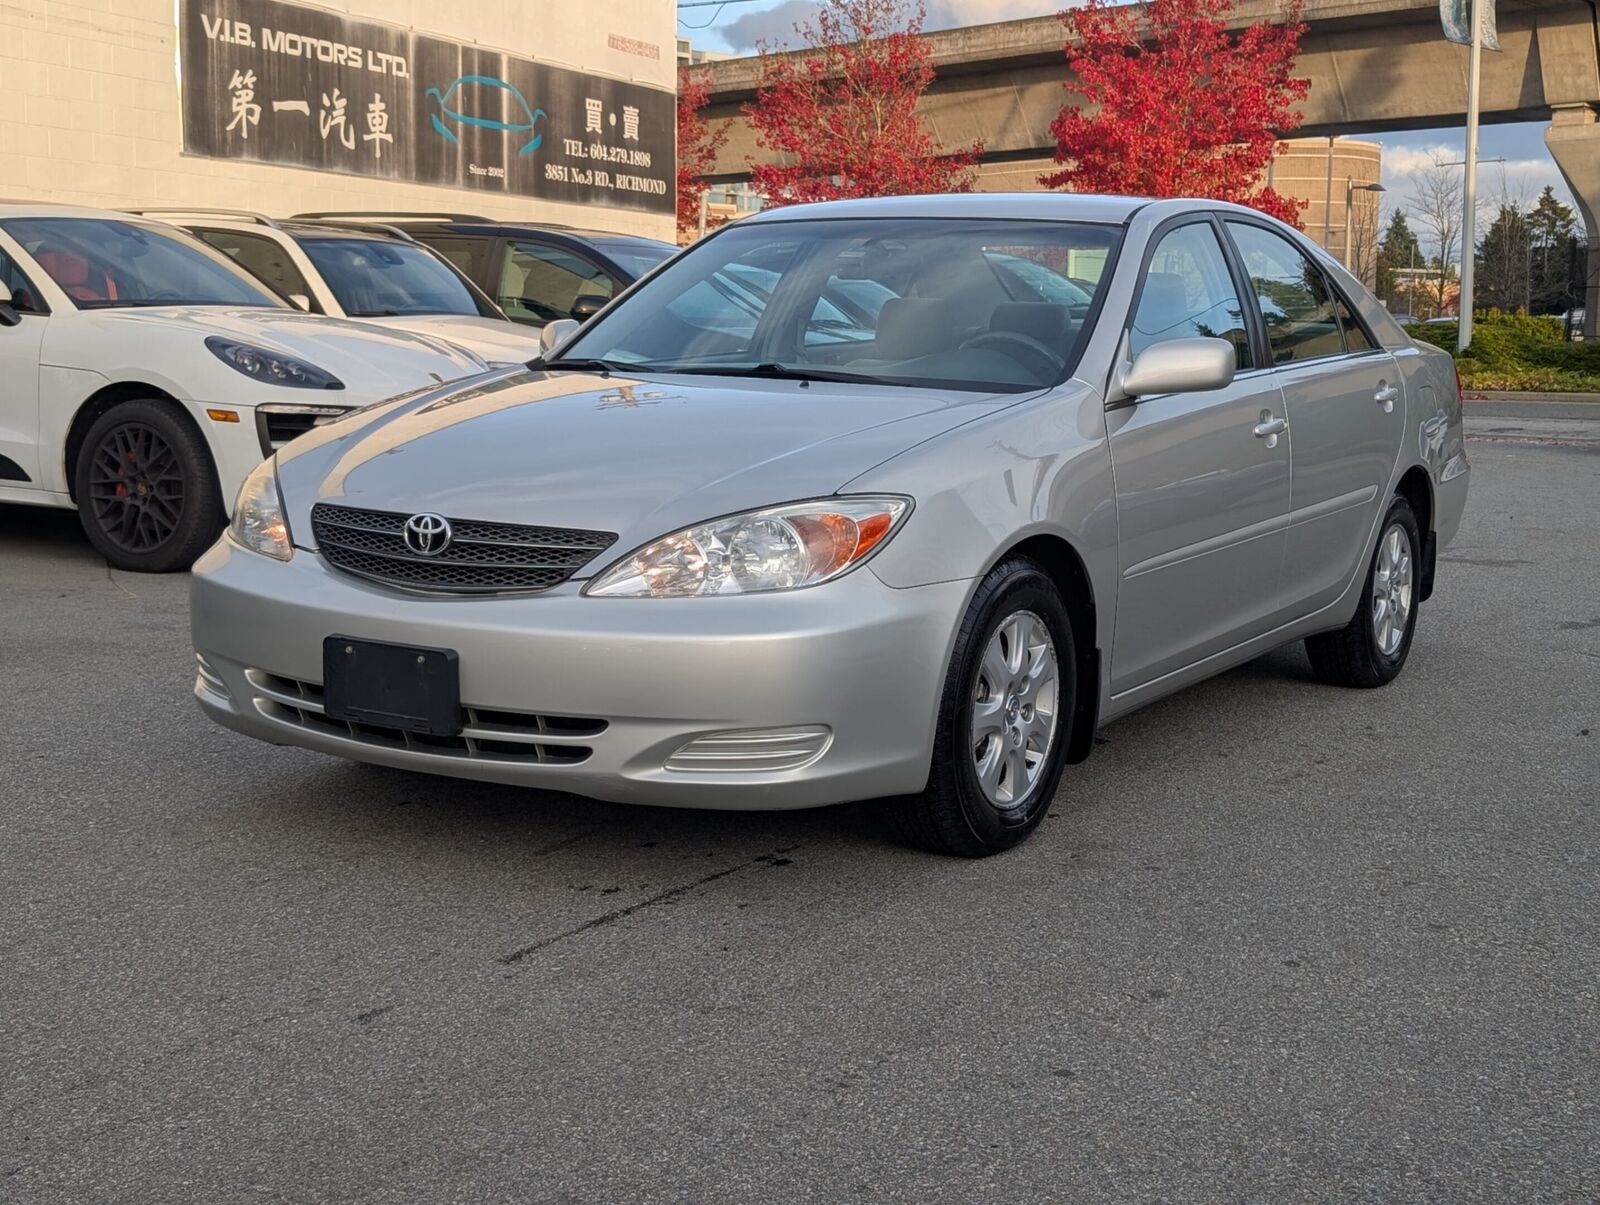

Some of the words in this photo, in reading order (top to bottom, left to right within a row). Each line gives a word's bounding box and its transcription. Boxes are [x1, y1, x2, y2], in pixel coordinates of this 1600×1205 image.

[201, 14, 256, 48] V.I.B.
[262, 28, 362, 69] MOTORS
[367, 50, 410, 79] LTD.
[226, 69, 393, 158] 第一汽車
[469, 163, 487, 176] Since
[563, 139, 588, 158] TEL:
[590, 143, 651, 168] 604.279.1898
[545, 163, 569, 182] 3851
[571, 167, 593, 186] No.3
[615, 173, 666, 195] RICHMOND
